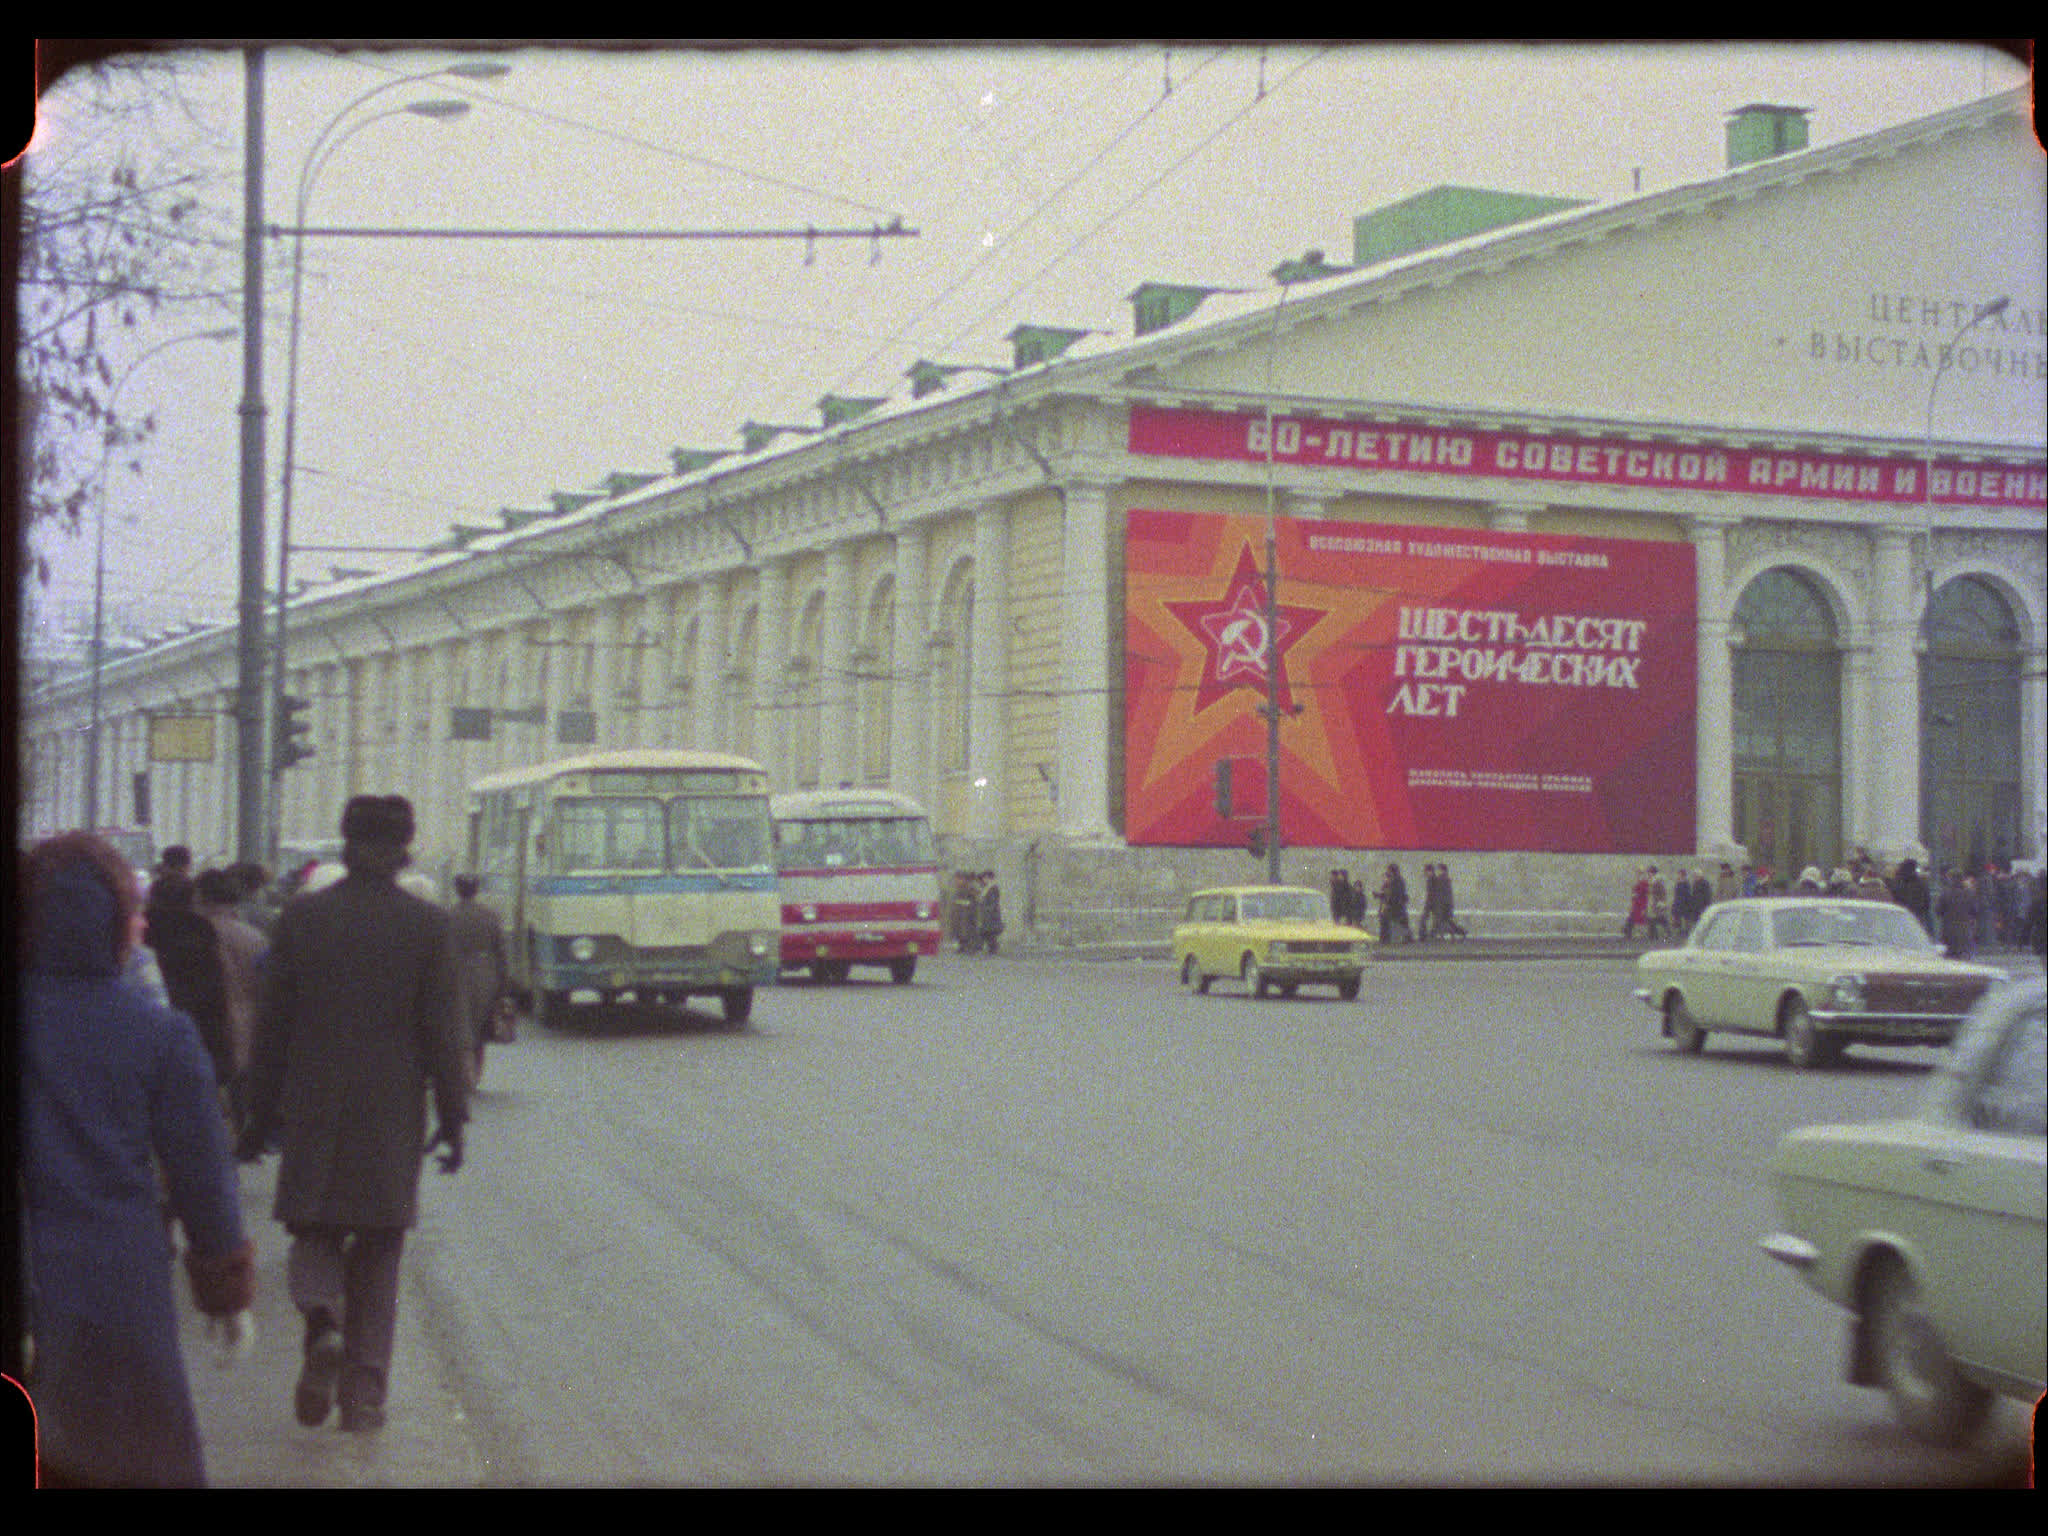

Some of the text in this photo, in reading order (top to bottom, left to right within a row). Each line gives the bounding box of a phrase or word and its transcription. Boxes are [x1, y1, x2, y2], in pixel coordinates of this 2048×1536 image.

[1871, 294, 2047, 335] ЦЕНТРАЛ
[1247, 419, 1473, 466] 60-ЛЕТИЮ
[1496, 440, 1729, 482] СОВЕТСКОЙ
[1750, 457, 1880, 493] АРМИИ
[1893, 466, 1916, 494] И
[1309, 535, 1609, 569] ВСЕСОЮЗНАЯ ХУДОЖЕСТВЕННАЯ ВЫСТАВКА
[1398, 606, 1646, 652] ШЕСТЬДЕСЯТ
[1394, 644, 1642, 689] ГЕРОИЧЕСКИХ
[1386, 683, 1467, 717] ЛЕТ
